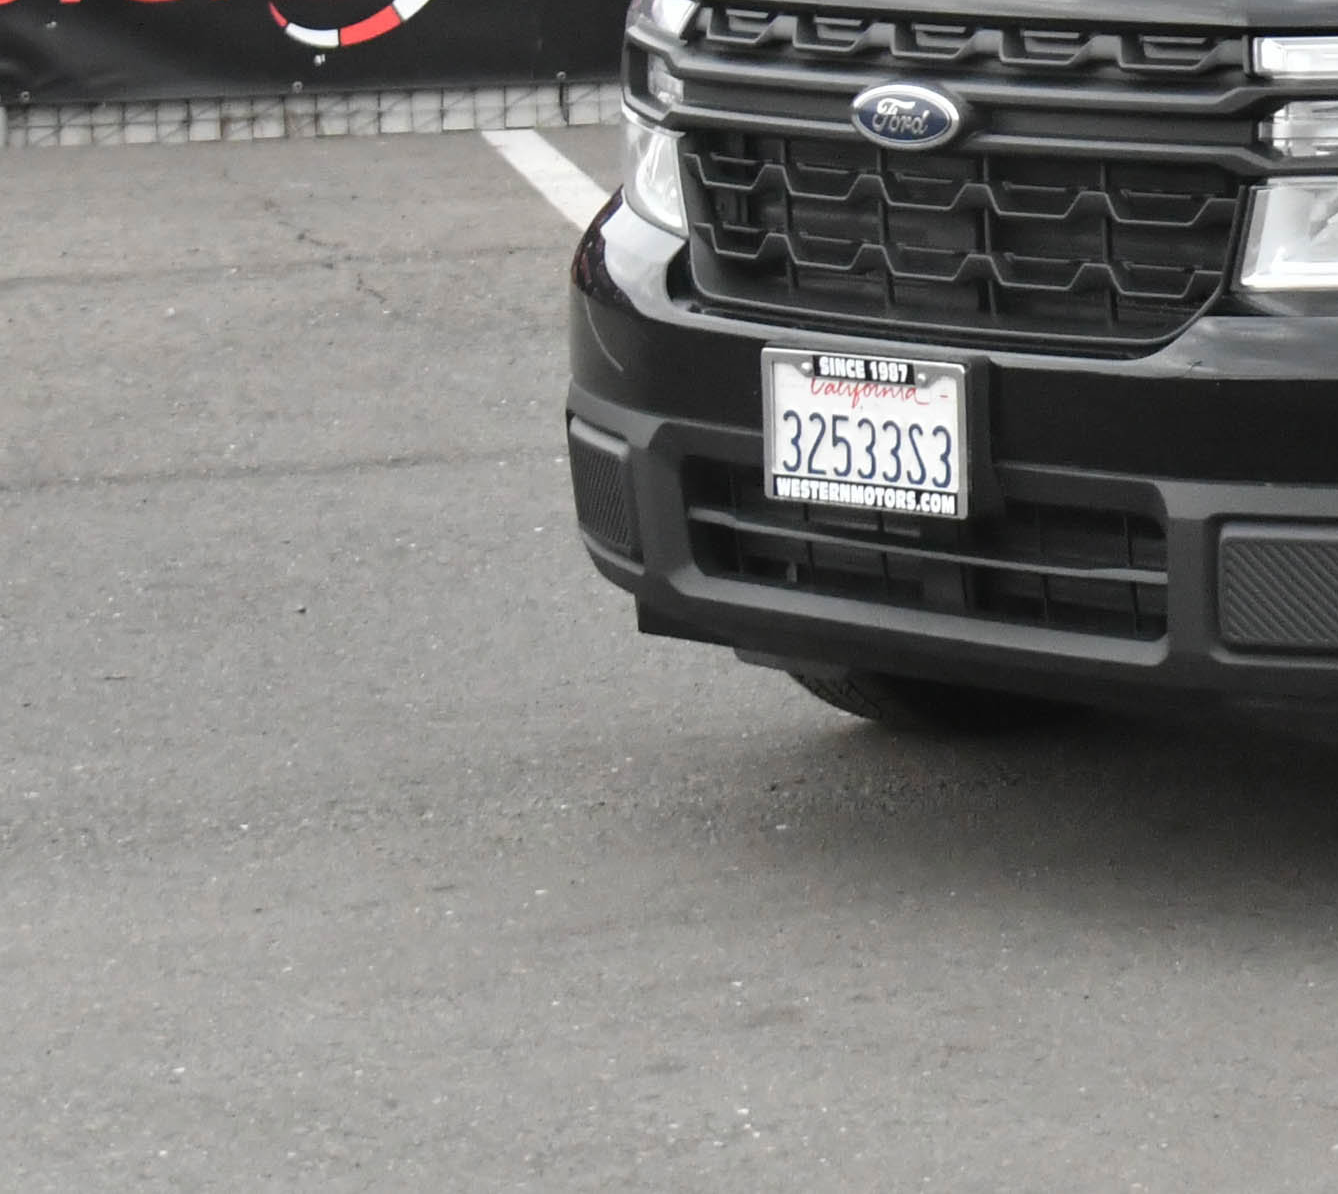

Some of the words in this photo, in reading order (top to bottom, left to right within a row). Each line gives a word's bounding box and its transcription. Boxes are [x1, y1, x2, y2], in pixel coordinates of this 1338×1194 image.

[871, 97, 931, 136] Ford
[818, 355, 866, 380] SINCE
[869, 361, 909, 383] 1987
[810, 377, 929, 409] California
[782, 409, 952, 489] 32533S3
[776, 476, 956, 515] WESTERNMOTORS.COM
